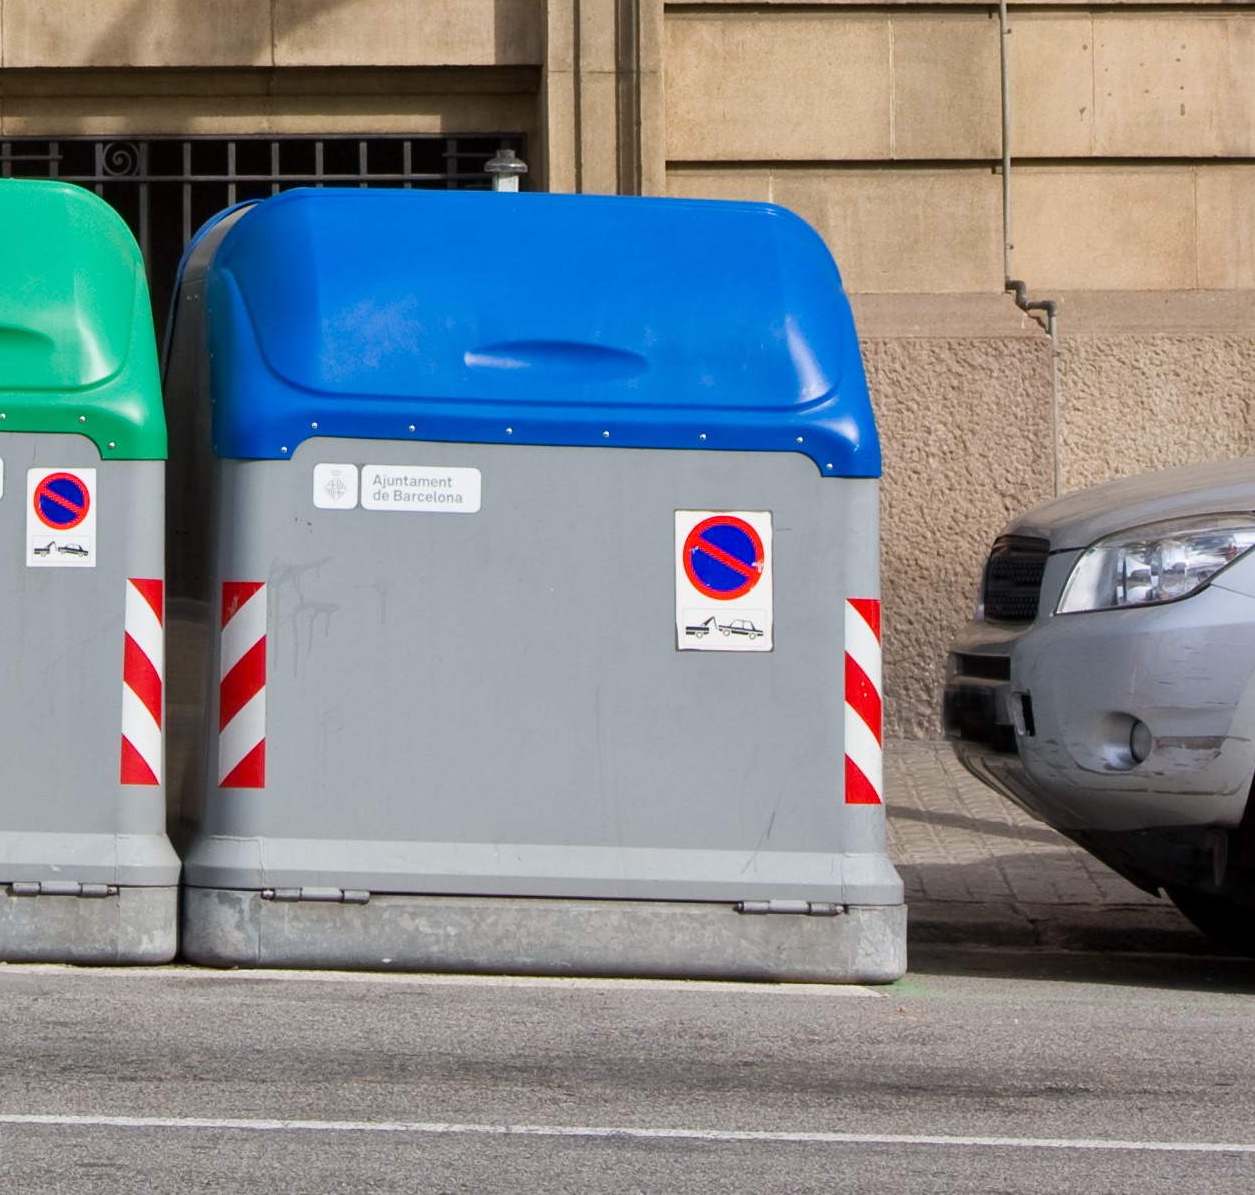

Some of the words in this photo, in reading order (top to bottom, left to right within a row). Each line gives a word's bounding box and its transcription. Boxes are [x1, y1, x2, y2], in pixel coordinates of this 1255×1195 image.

[373, 474, 453, 489] Ajuntament
[373, 489, 390, 502] de
[393, 489, 463, 504] Barcelona
